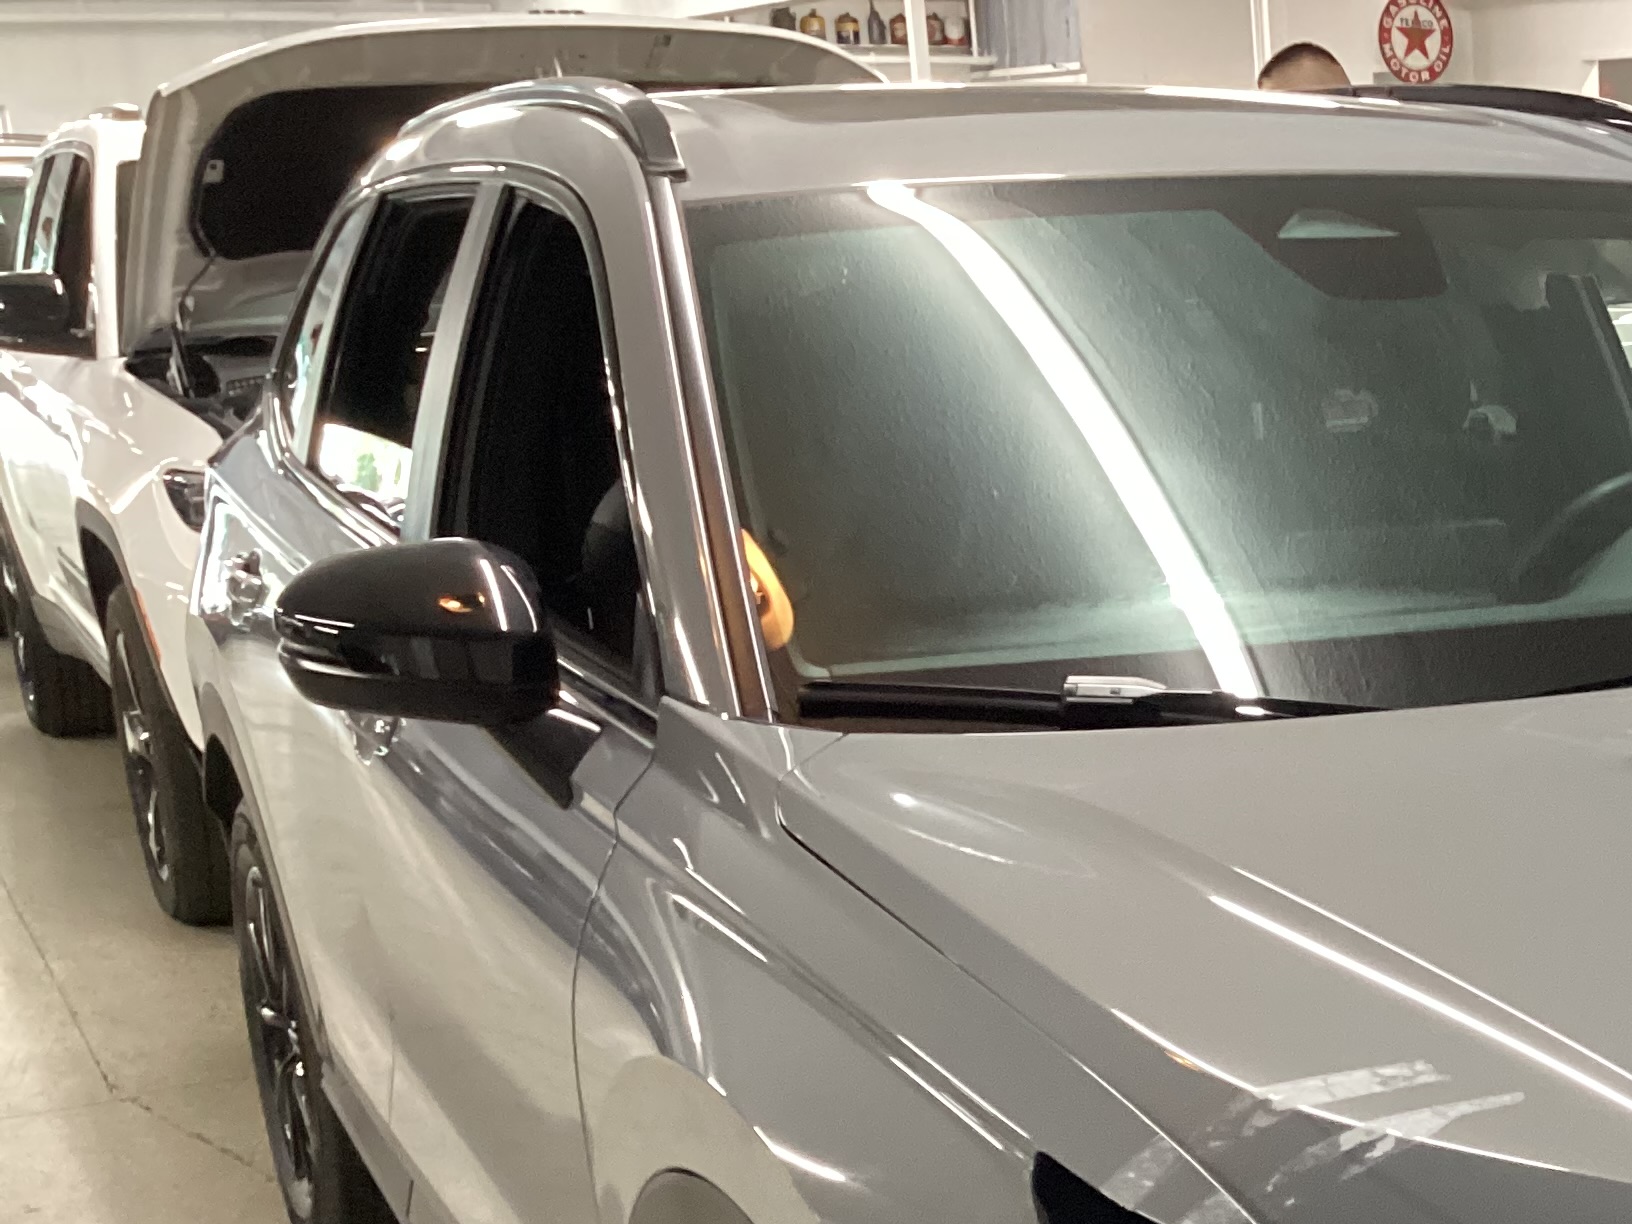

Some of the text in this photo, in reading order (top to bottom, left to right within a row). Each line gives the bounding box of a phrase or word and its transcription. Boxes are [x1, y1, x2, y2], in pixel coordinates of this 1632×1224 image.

[1400, 17, 1434, 27] TECO
[1382, 43, 1451, 82] MOTOR OIL
